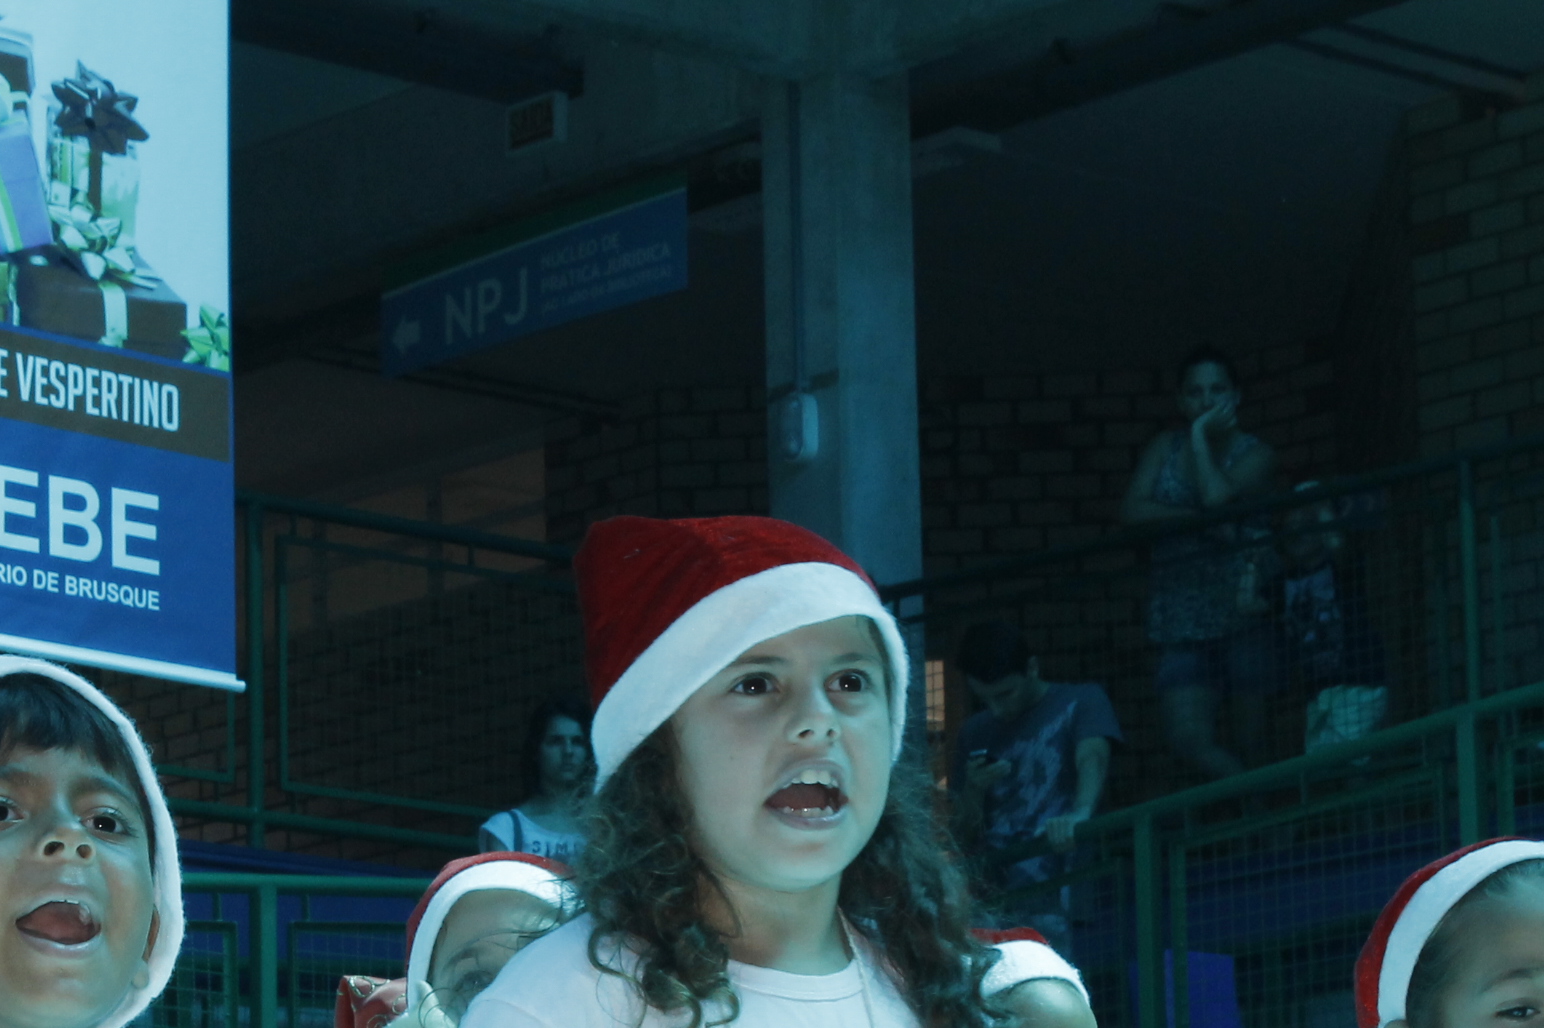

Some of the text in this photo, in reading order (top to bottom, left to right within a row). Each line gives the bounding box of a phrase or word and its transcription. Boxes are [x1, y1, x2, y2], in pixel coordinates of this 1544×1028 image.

[444, 265, 529, 346] NPJ
[16, 353, 180, 433] VESPERTINO
[32, 566, 59, 592] DE
[64, 575, 161, 612] BRUSQUE
